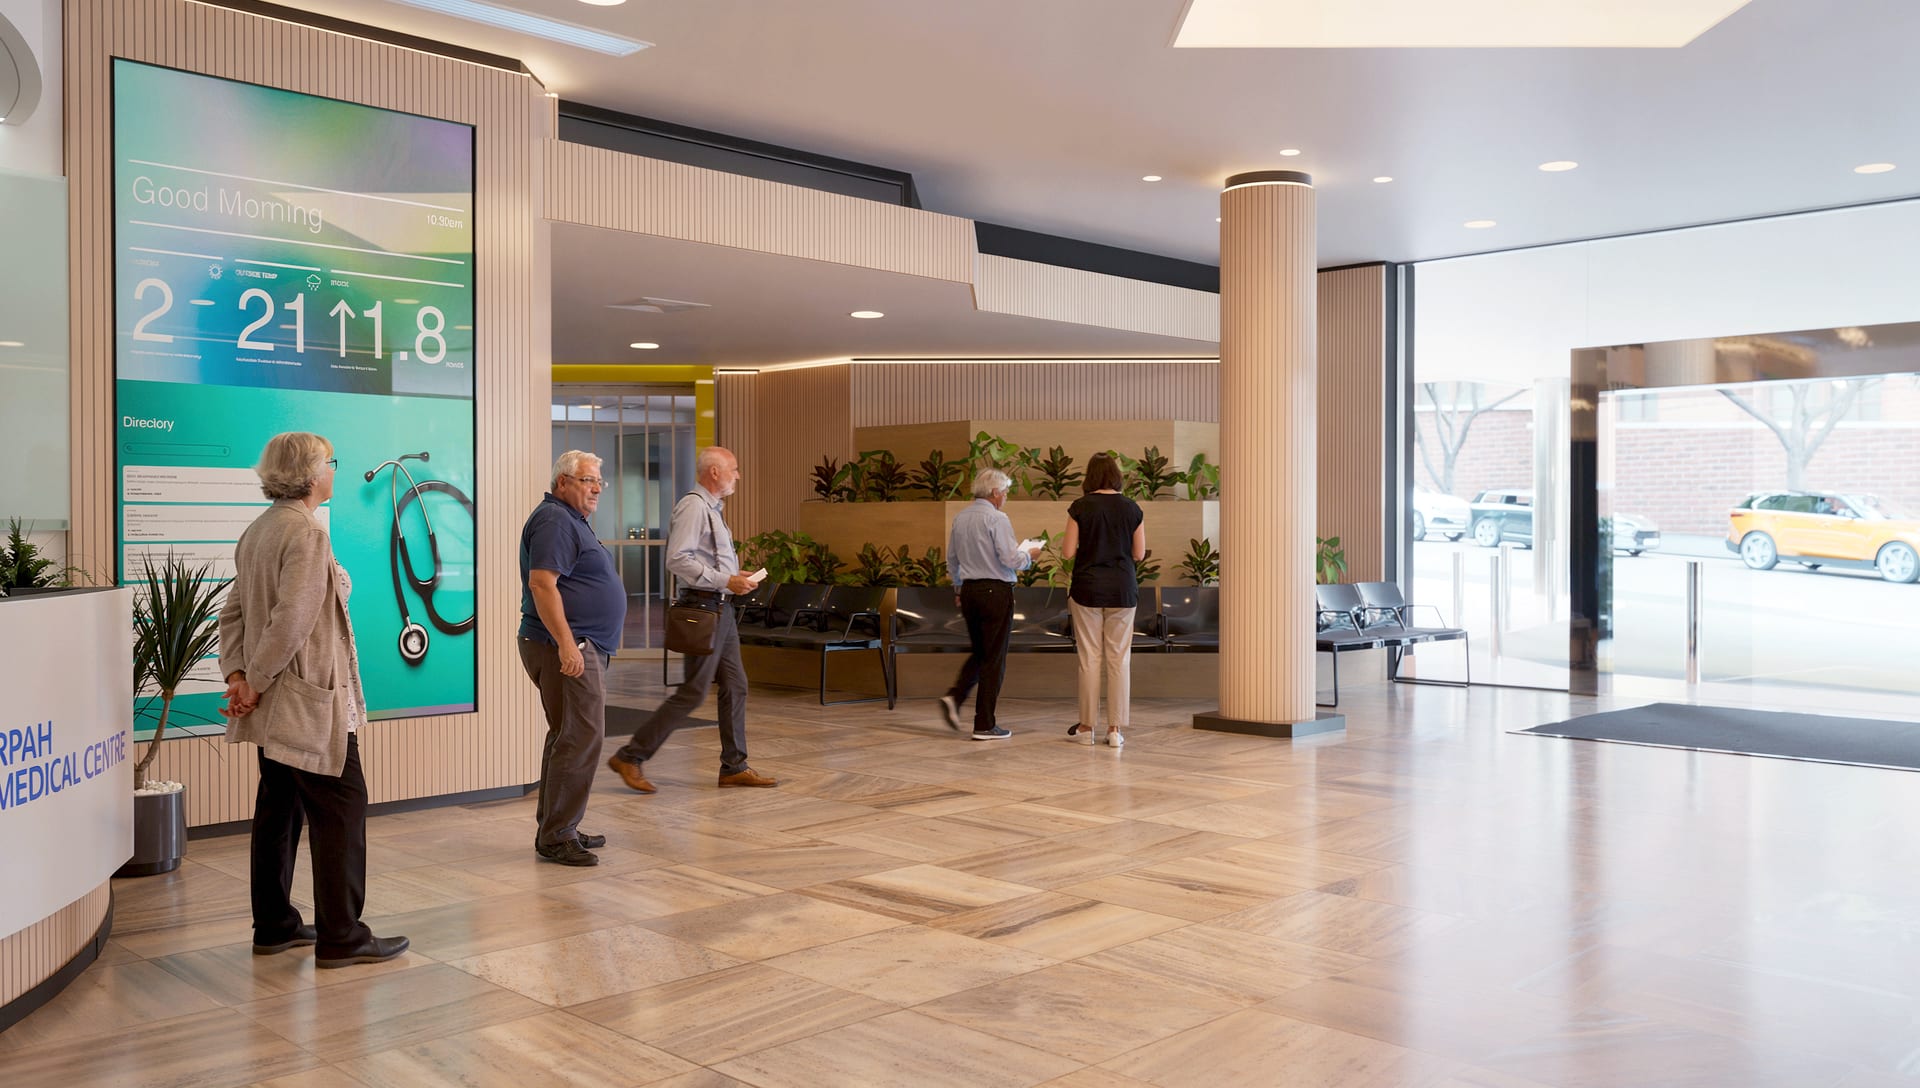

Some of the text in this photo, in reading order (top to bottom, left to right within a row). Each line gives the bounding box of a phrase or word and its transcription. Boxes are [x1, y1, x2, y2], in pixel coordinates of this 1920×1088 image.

[132, 176, 323, 234] Good Morning
[132, 278, 174, 343] 2
[237, 288, 305, 354] 21
[123, 416, 175, 432] Directory
[0, 730, 126, 810] MEDICAL CENTRE
